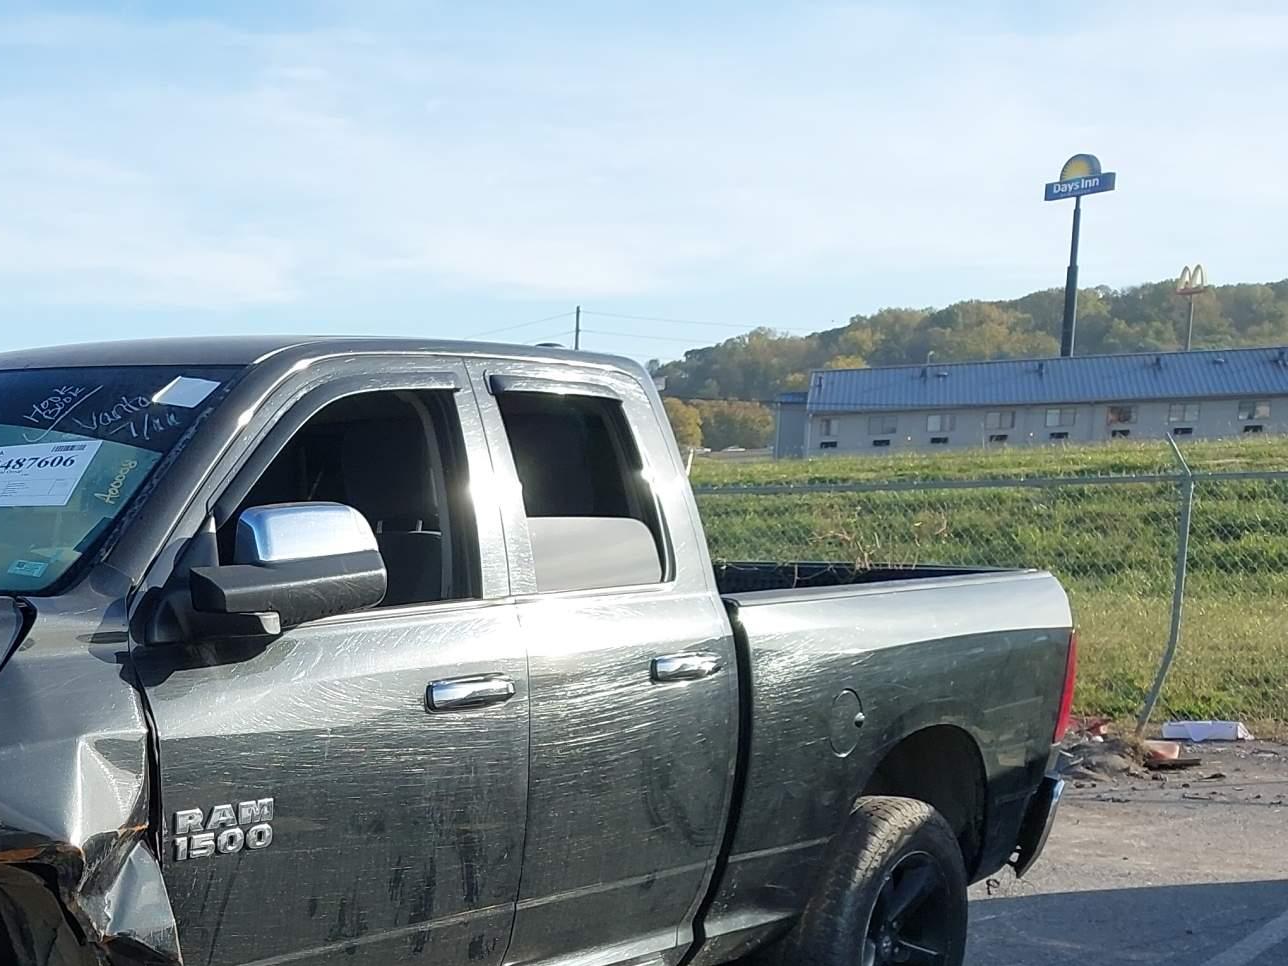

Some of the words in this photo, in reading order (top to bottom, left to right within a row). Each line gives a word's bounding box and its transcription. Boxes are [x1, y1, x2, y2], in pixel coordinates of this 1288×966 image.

[1053, 181, 1081, 195] Days
[1081, 178, 1100, 189] Inn
[175, 797, 274, 835] RAM
[175, 823, 273, 861] 1500
